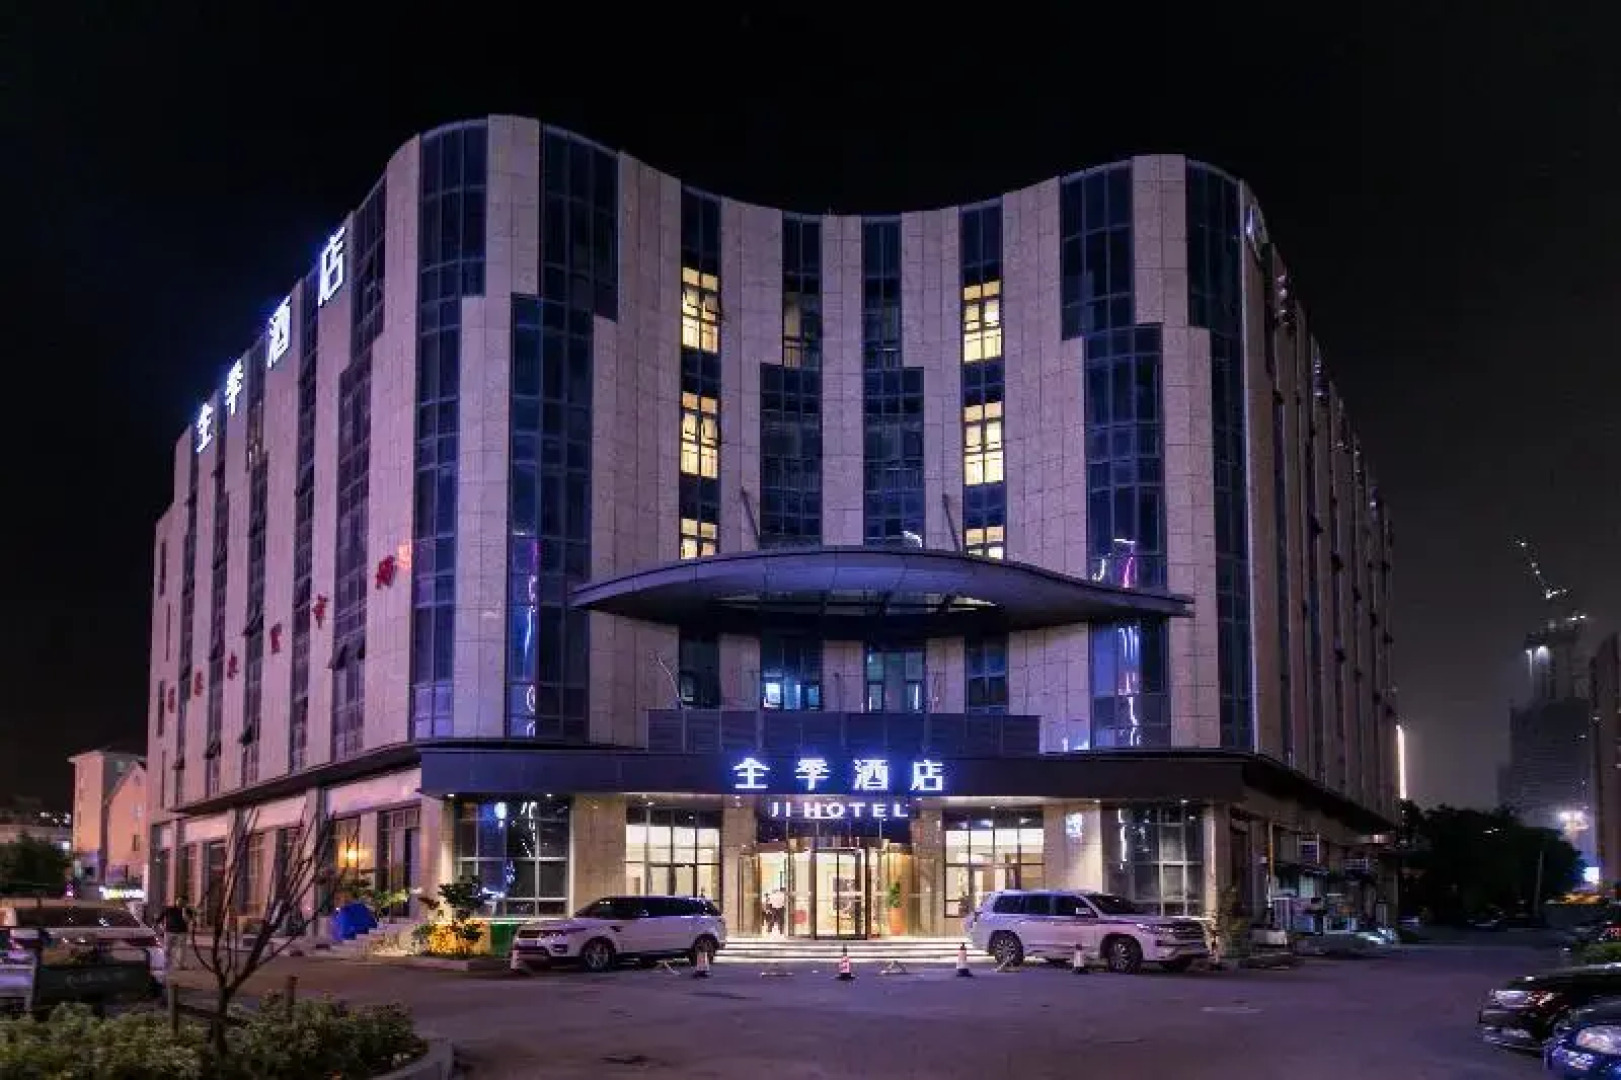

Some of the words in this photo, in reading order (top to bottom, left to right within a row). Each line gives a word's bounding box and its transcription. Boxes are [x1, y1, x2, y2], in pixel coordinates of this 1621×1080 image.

[196, 227, 346, 453] 全季酒店
[732, 757, 945, 791] 全季酒店
[771, 802, 791, 818] JI
[803, 802, 909, 819] HOTEL
